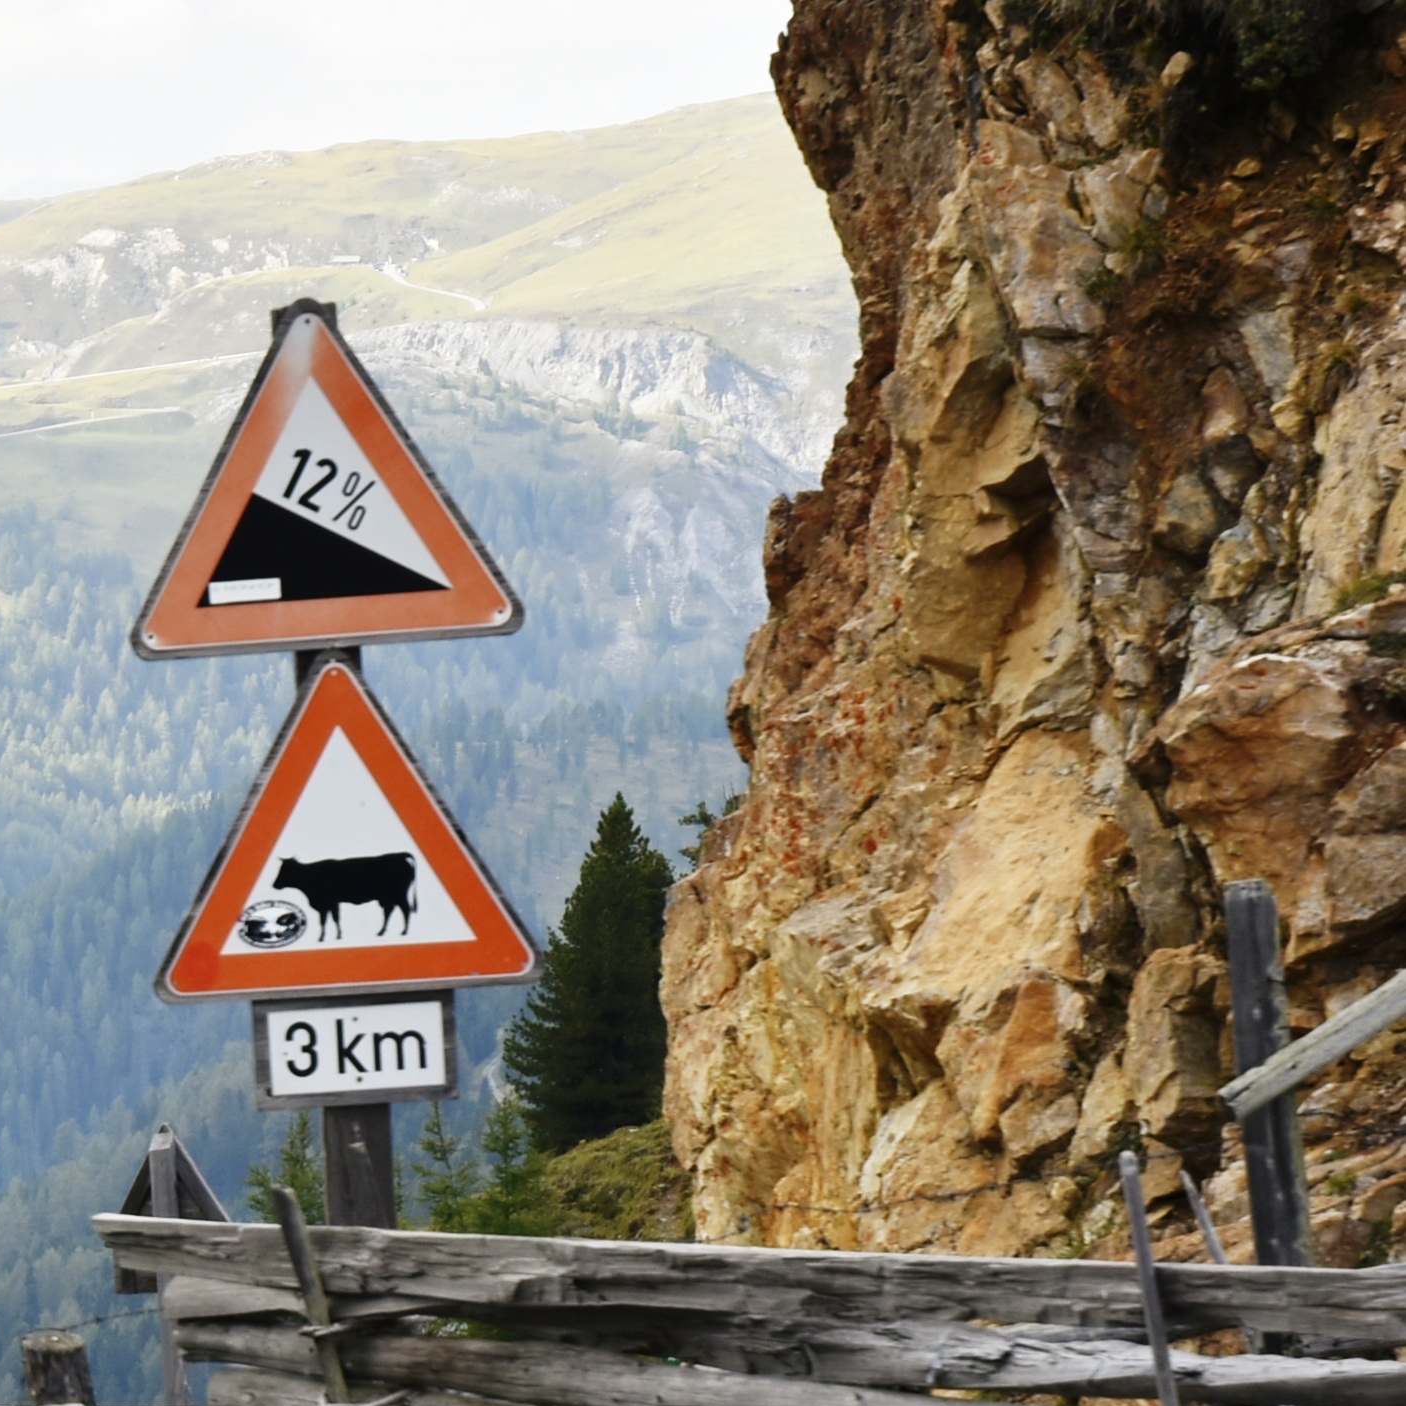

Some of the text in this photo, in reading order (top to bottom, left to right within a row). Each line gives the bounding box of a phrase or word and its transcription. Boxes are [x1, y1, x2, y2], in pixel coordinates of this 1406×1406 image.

[283, 448, 375, 530] 12%
[285, 1019, 427, 1077] 3 km
